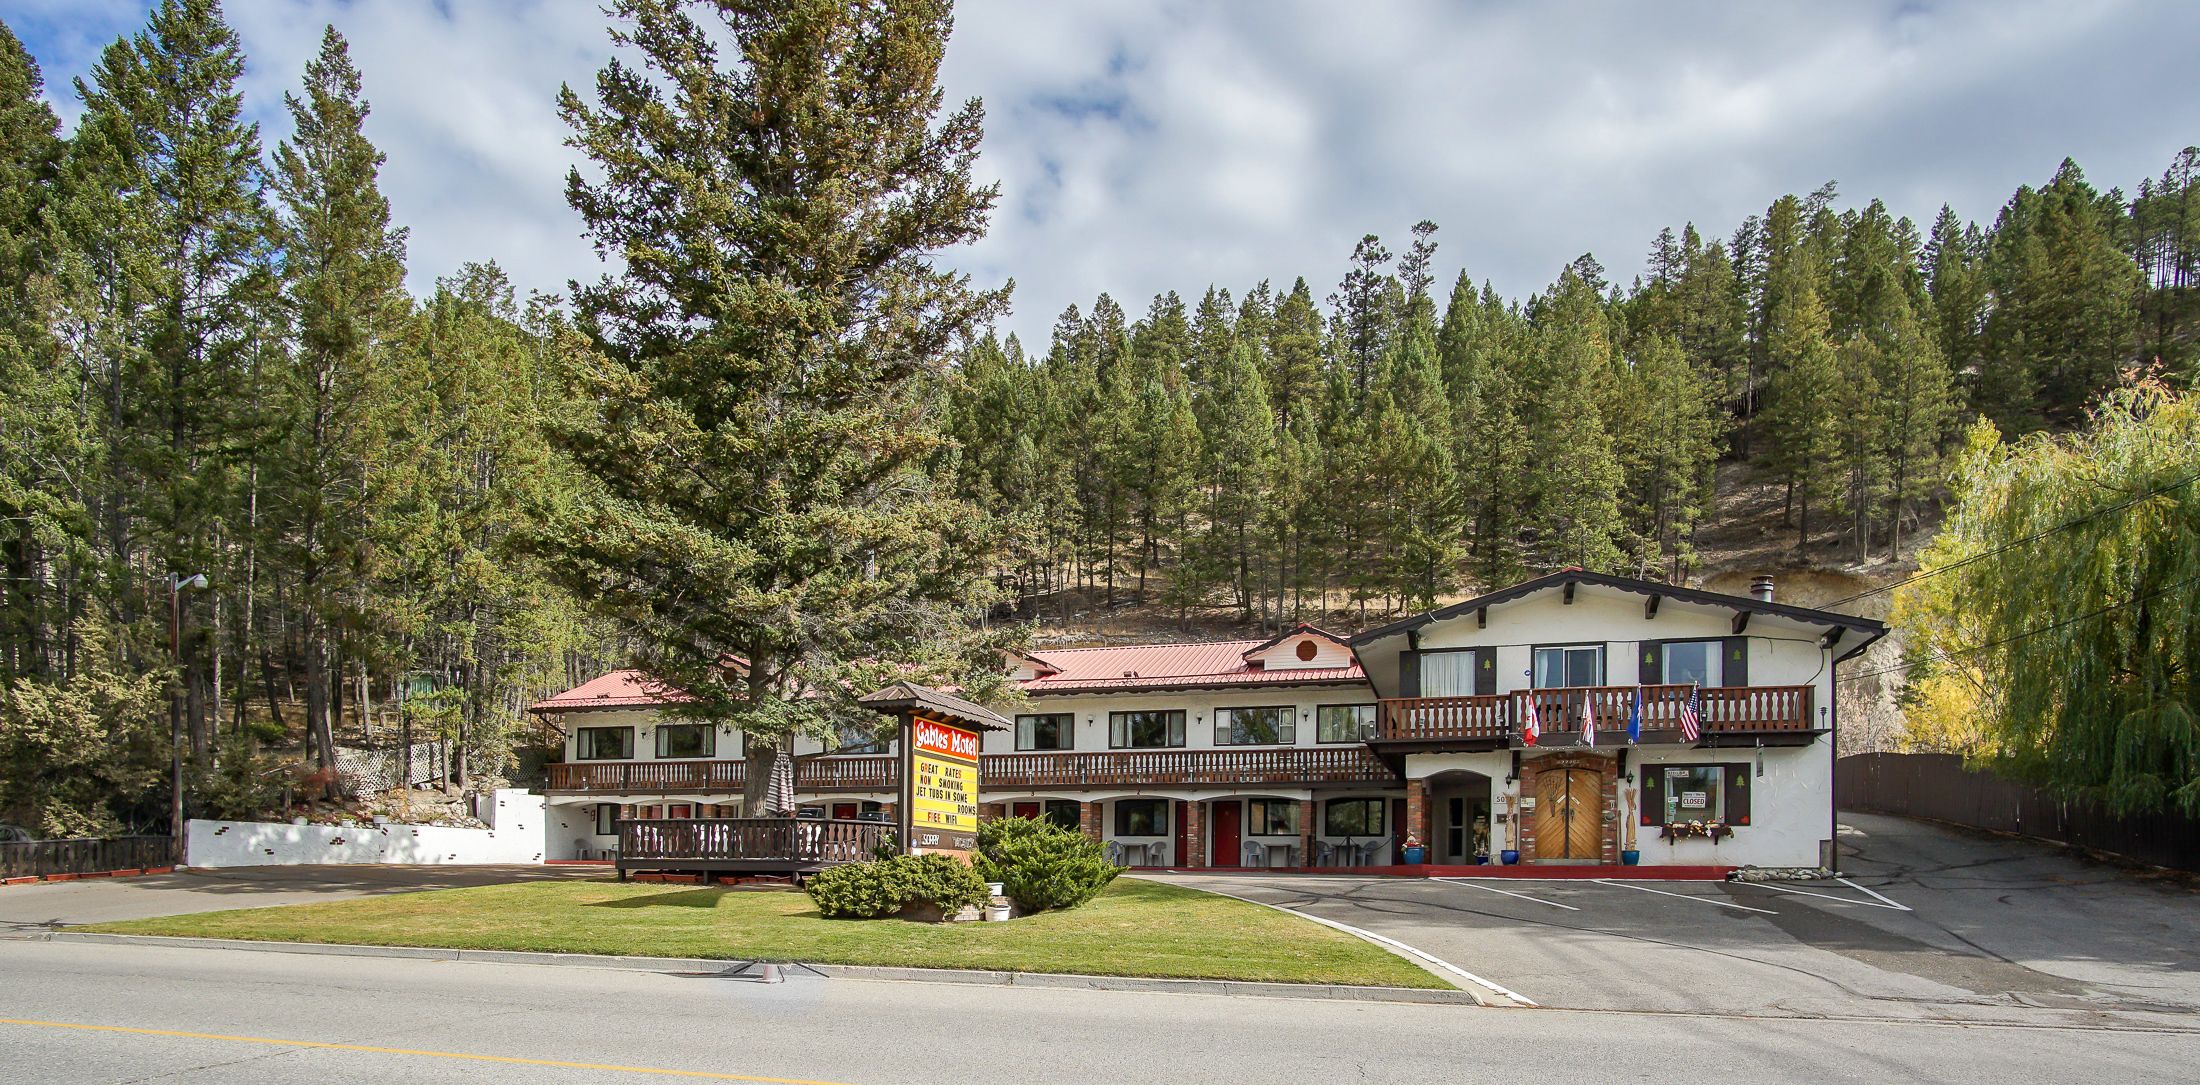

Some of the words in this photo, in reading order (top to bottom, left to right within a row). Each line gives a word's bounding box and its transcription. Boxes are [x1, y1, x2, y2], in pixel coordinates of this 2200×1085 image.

[916, 721, 949, 750] Gables
[951, 730, 977, 757] Motel
[920, 762, 938, 775] GREAT
[944, 767, 962, 779] RATES
[920, 775, 931, 786] NON
[938, 778, 963, 792] SMOKING
[916, 786, 926, 797] JET
[929, 788, 943, 800] TUBS
[945, 791, 951, 801] IN
[952, 792, 968, 804] SOME
[927, 811, 941, 823] FEE
[945, 814, 958, 825] WIFI
